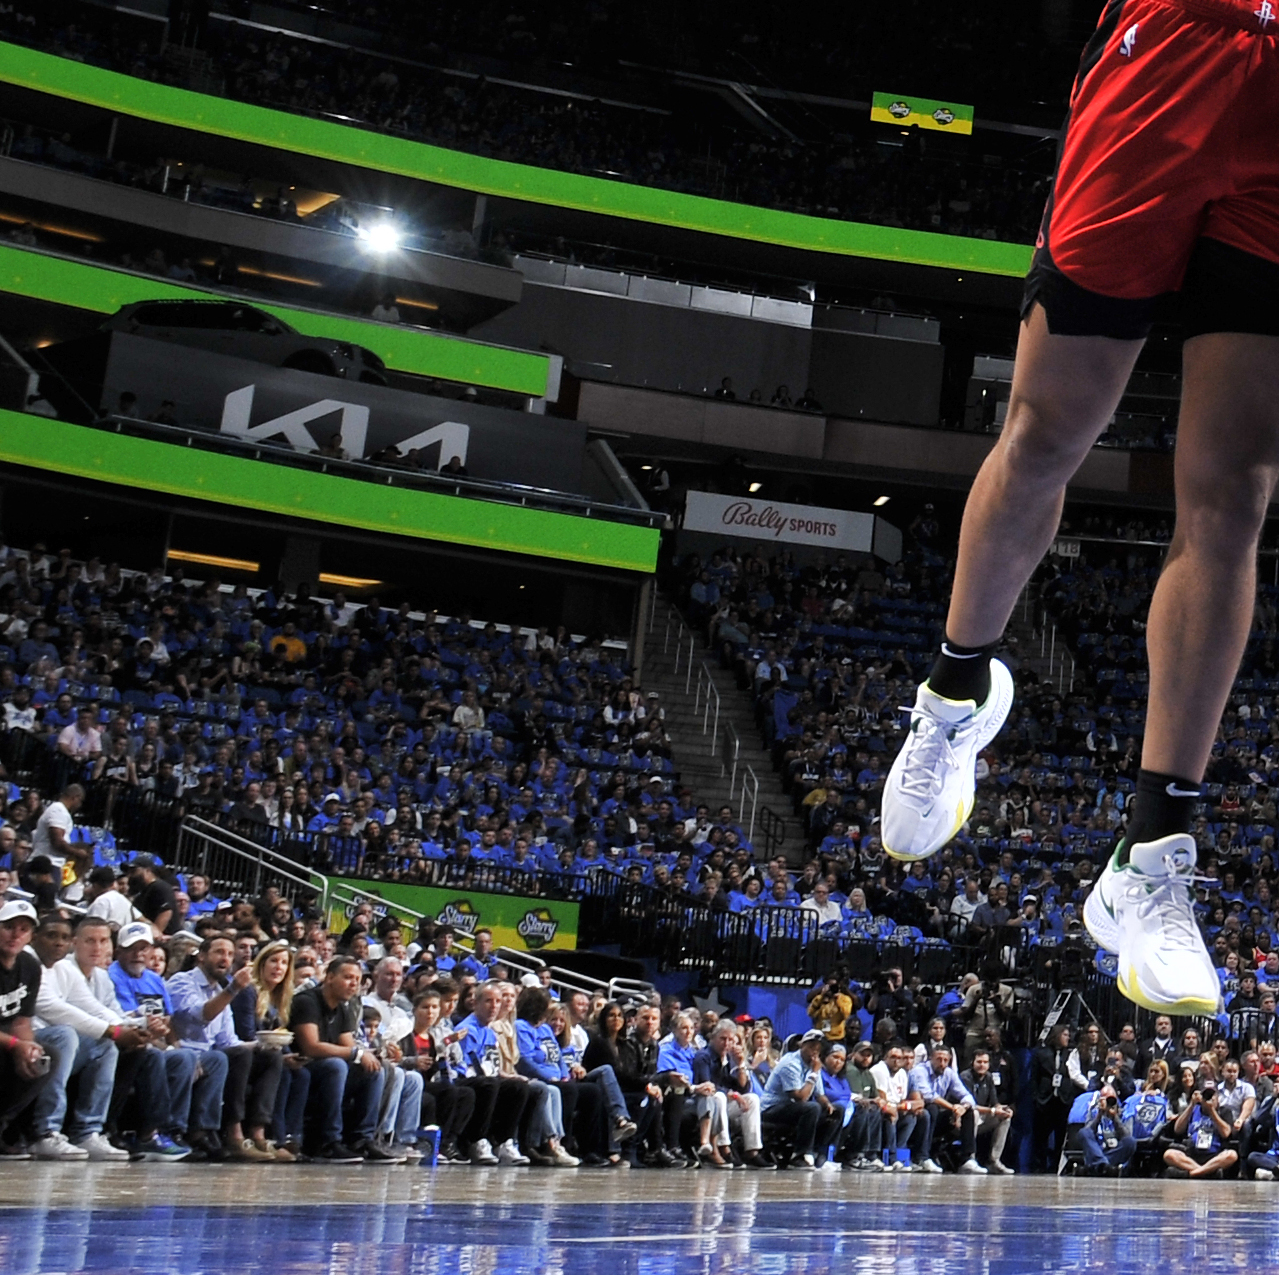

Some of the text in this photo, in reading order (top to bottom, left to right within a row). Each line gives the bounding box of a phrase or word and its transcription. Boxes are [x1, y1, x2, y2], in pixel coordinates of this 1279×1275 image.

[722, 502, 837, 537] Bally SPORTS
[518, 913, 558, 940] Starry
